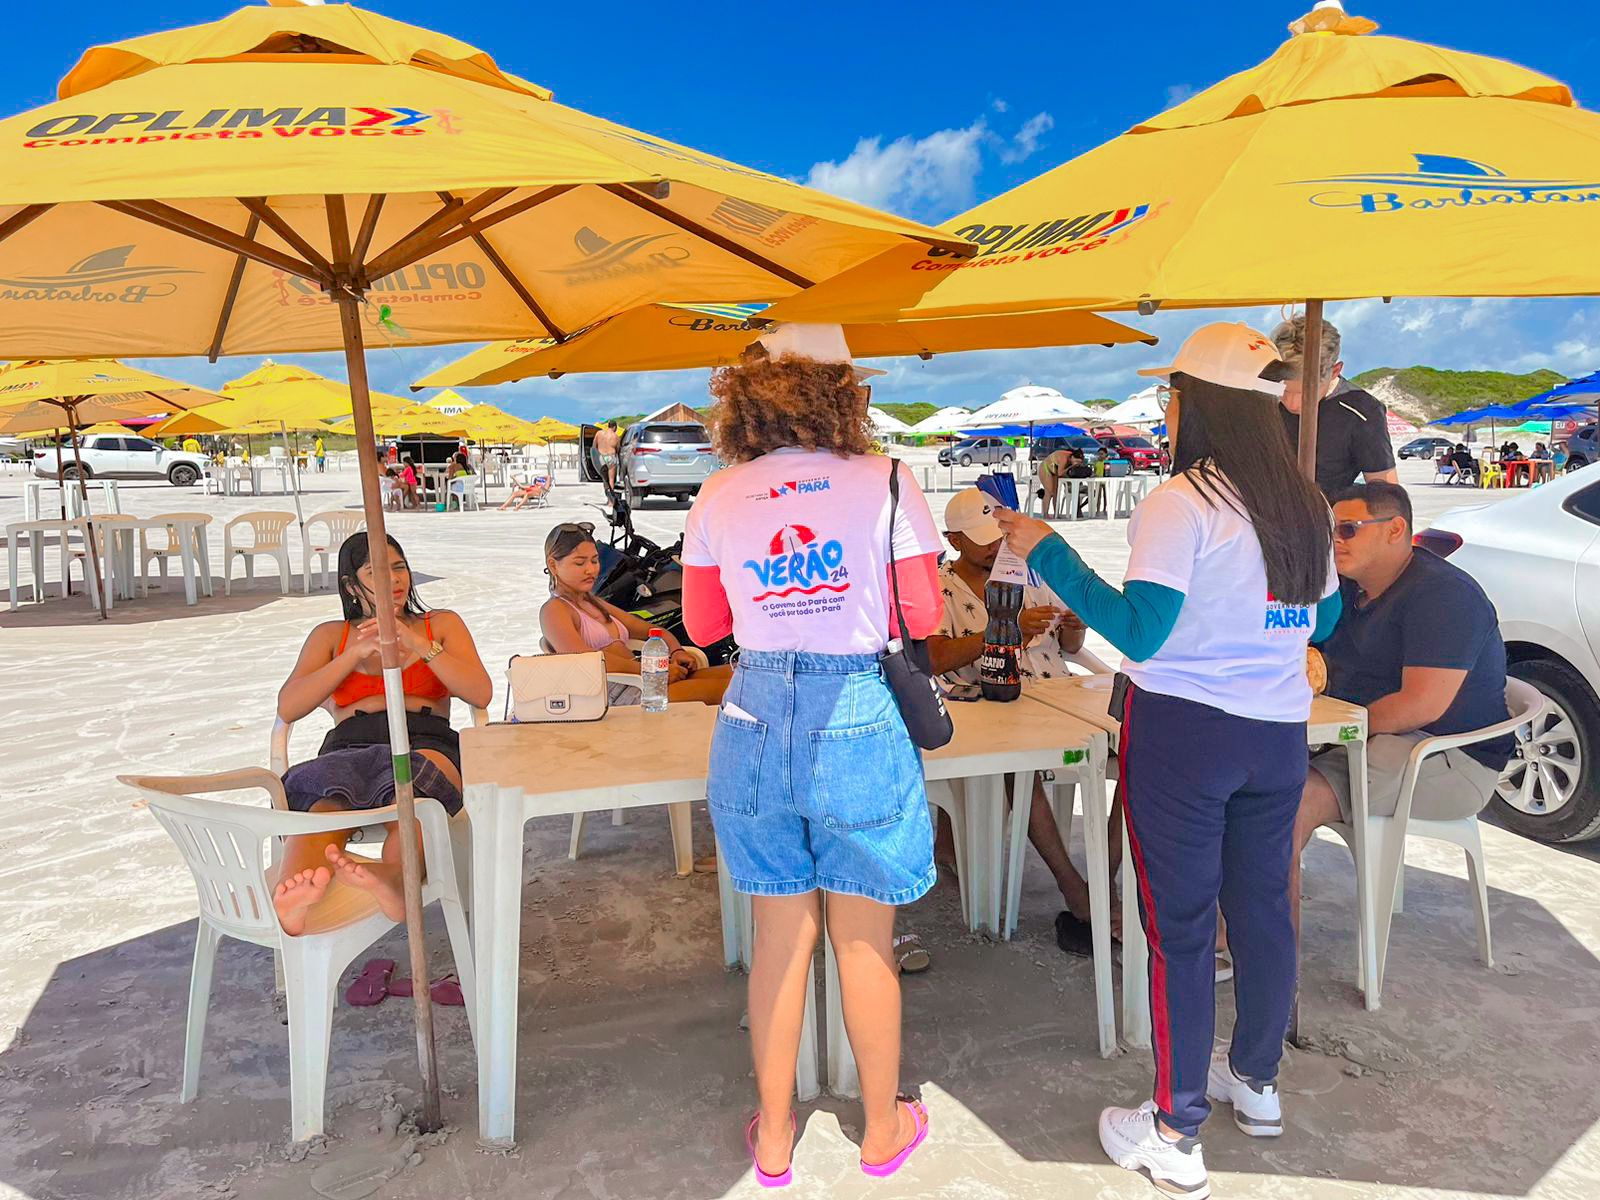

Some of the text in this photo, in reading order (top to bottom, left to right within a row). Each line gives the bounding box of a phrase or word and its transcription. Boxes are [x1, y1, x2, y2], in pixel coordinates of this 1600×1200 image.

[26, 107, 346, 138] OPLIMA
[23, 129, 264, 149] Completa
[743, 540, 843, 588] VERÃO
[830, 566, 849, 583] 24
[808, 596, 828, 606] Pará
[828, 595, 845, 603] com
[769, 609, 786, 618] você
[796, 608, 814, 616] todo
[822, 603, 841, 612] Pará
